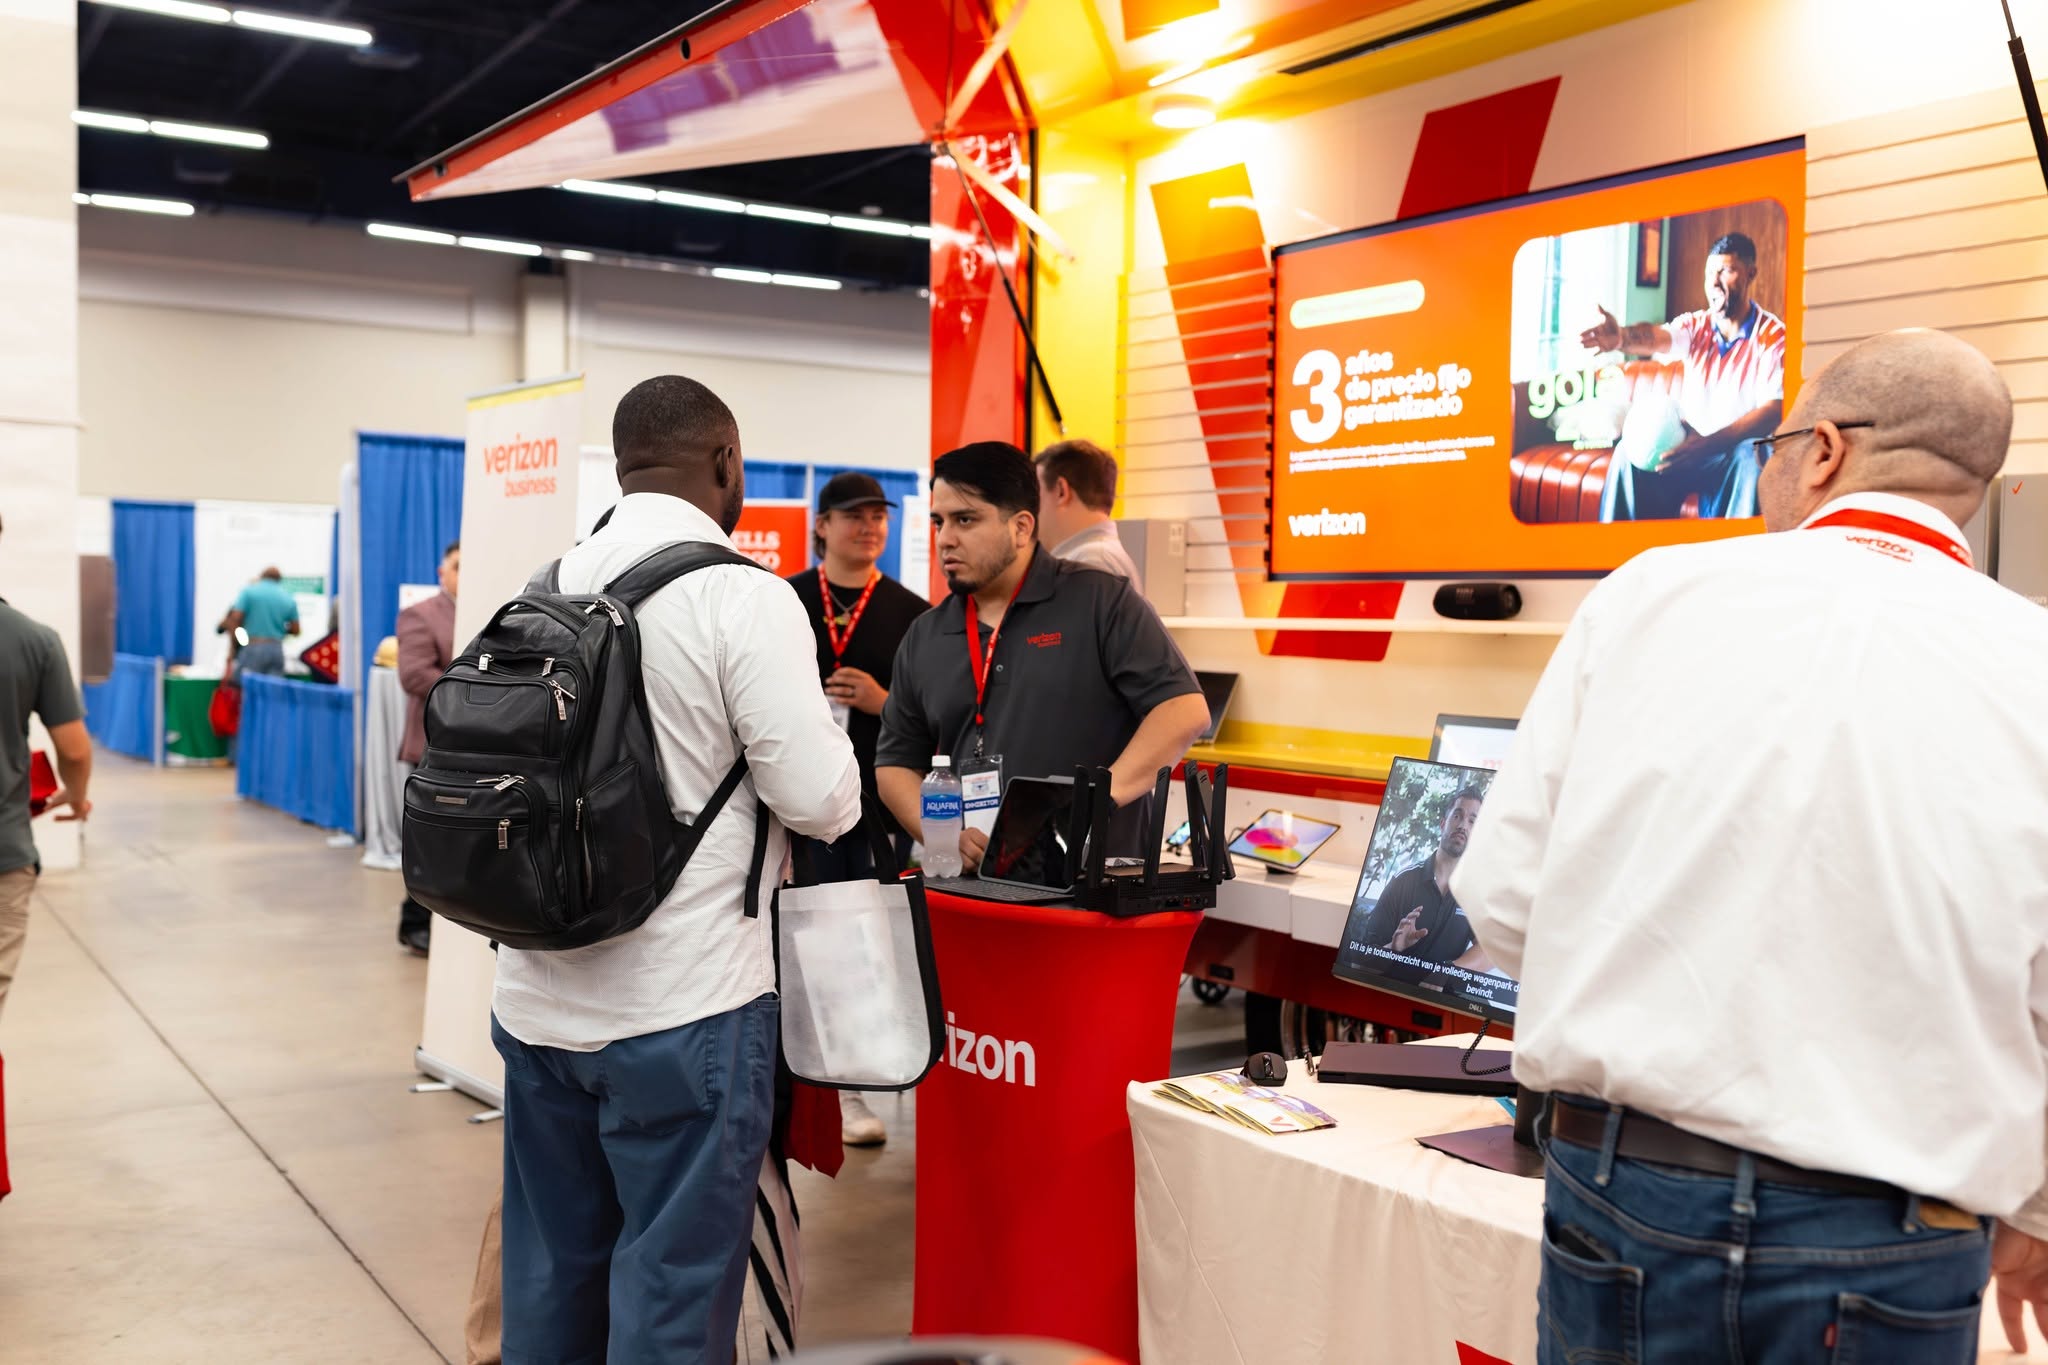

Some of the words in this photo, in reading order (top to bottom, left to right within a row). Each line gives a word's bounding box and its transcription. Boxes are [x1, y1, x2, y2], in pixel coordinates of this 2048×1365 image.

[1345, 350, 1393, 376] años
[1290, 349, 1342, 444] 3
[1344, 376, 1370, 401] de
[1371, 368, 1436, 403] precio
[1437, 363, 1472, 395] fijo
[1344, 391, 1463, 430] garantizado
[483, 432, 558, 474] verizon
[504, 476, 557, 498] business
[1288, 508, 1366, 537] verizon
[730, 530, 780, 550] ELLS
[1846, 535, 1914, 558] verizon
[926, 801, 959, 811] AQUAFINA
[1349, 941, 1359, 951] Dit
[1359, 943, 1366, 953] is
[1365, 945, 1373, 955] je
[1373, 947, 1420, 967] totaaloverzicht
[1421, 960, 1433, 970] van
[1433, 962, 1441, 973] je
[1442, 965, 1472, 981] volledige
[1473, 974, 1512, 991] wagenpark
[1466, 984, 1494, 999] bevindt.
[1469, 1003, 1483, 1013] DELL
[940, 1010, 1036, 1087] izon
